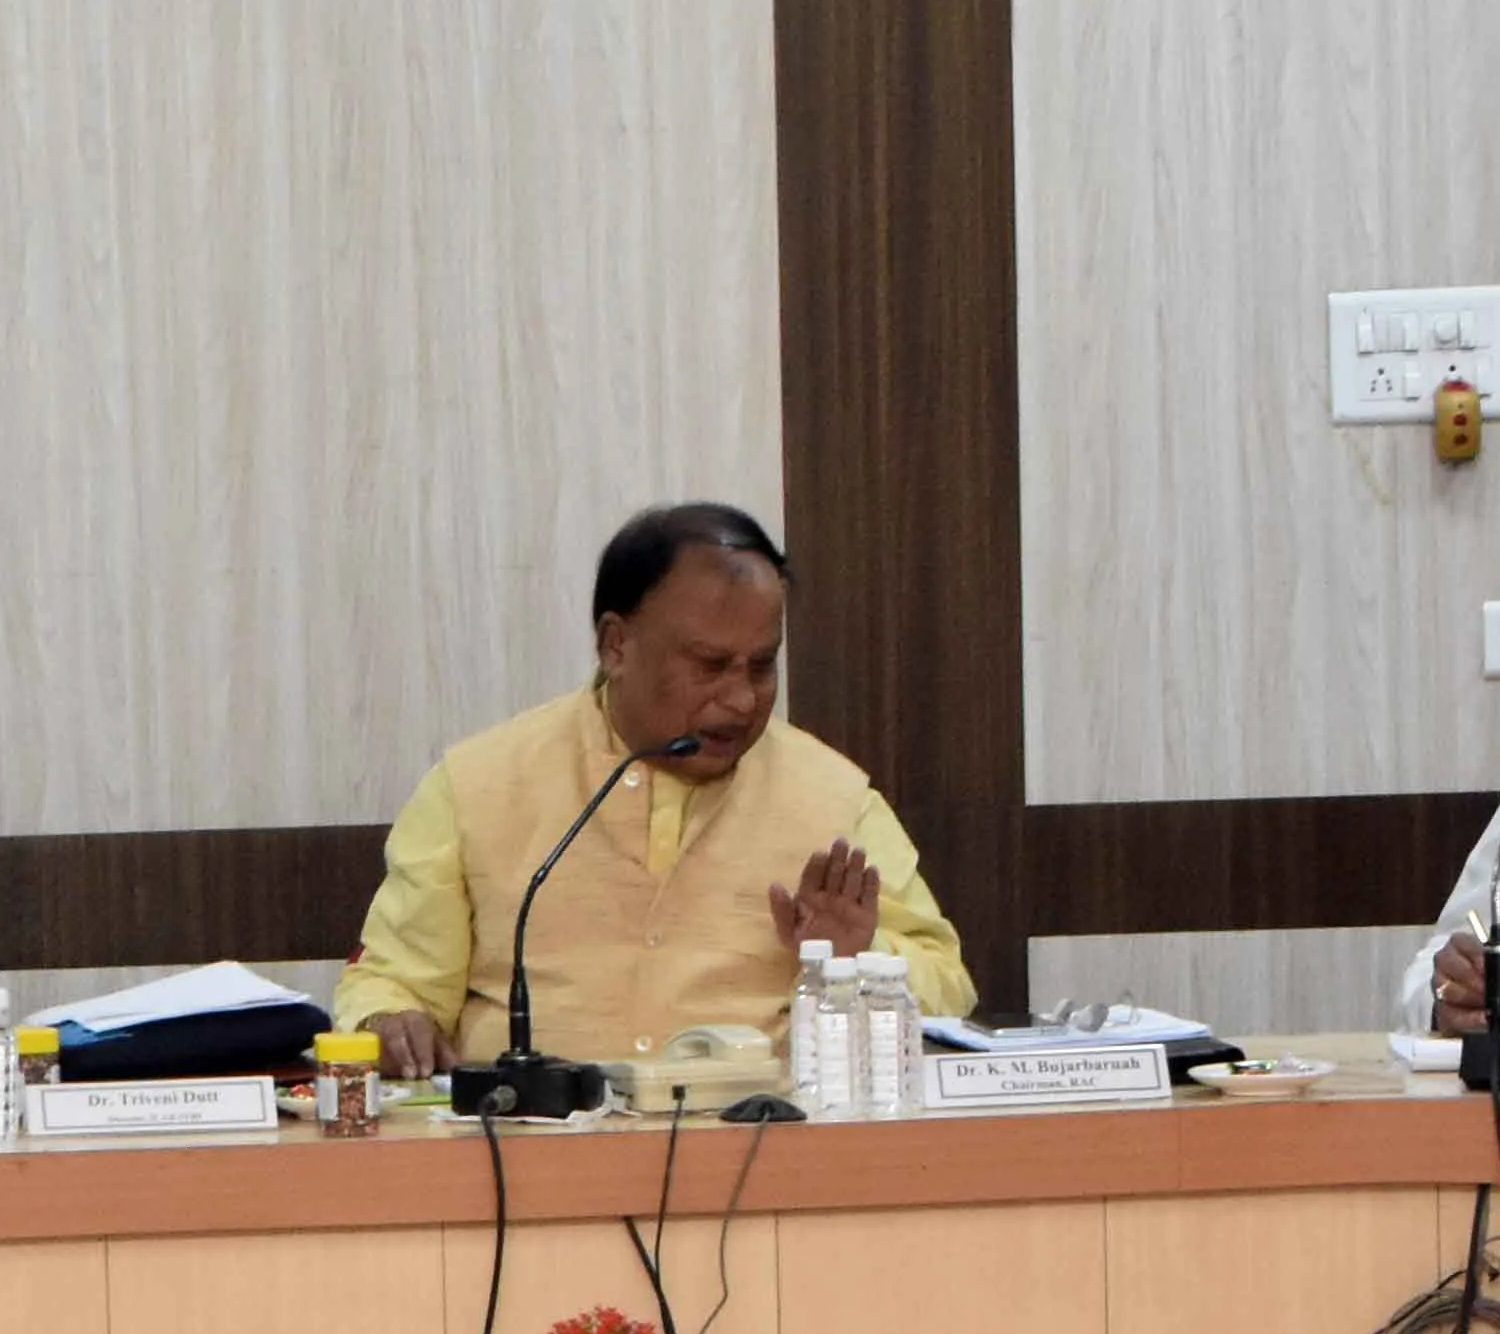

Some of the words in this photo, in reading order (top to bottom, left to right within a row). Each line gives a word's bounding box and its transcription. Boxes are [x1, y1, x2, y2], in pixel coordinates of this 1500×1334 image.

[956, 1064, 982, 1077] Dr.
[88, 1094, 113, 1107] Dr.
[121, 1091, 178, 1106] Triveni
[184, 1089, 219, 1104] Dutt
